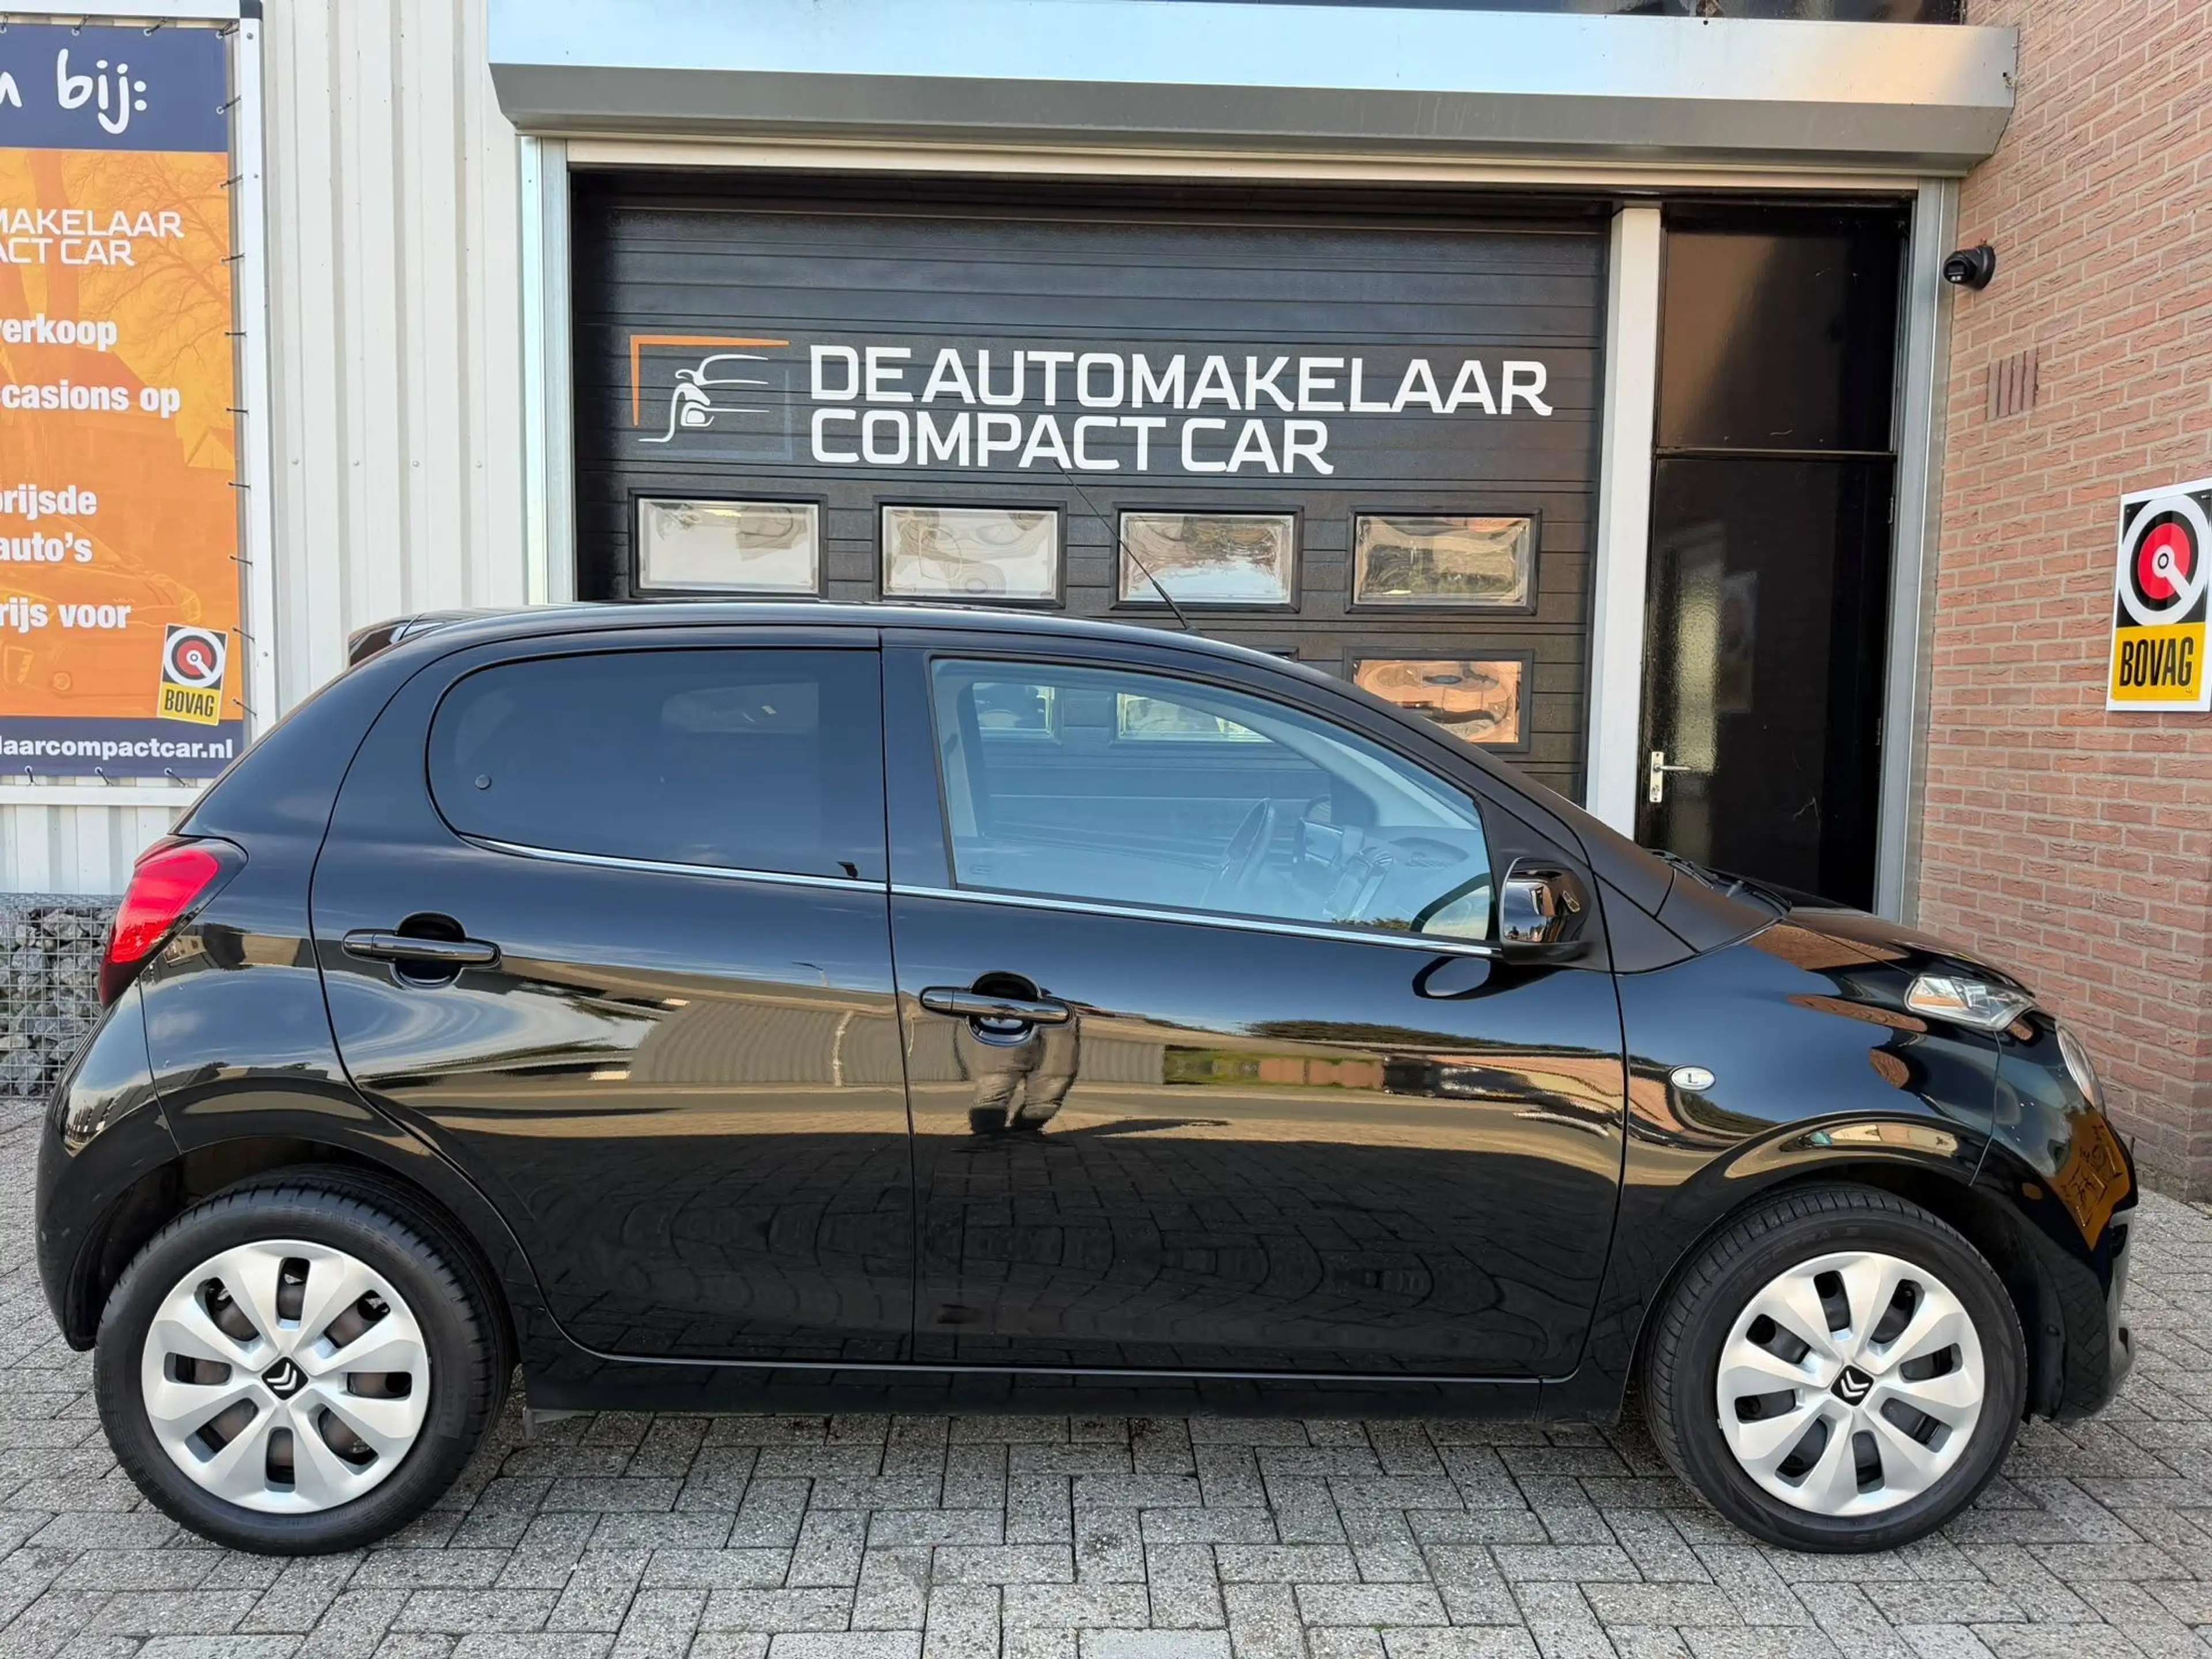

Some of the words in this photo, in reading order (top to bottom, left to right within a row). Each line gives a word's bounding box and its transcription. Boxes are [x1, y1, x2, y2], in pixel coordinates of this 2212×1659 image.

[58, 48, 147, 134] bij:
[60, 238, 135, 266] CAR
[0, 313, 118, 352] erkoop
[139, 387, 181, 419] op
[811, 408, 1167, 471] COMPACT
[1181, 418, 1335, 475] CAR
[0, 483, 97, 520] rijsde
[58, 604, 132, 628] voor
[2119, 637, 2194, 687] BOVAG
[164, 688, 215, 717] BOVAG
